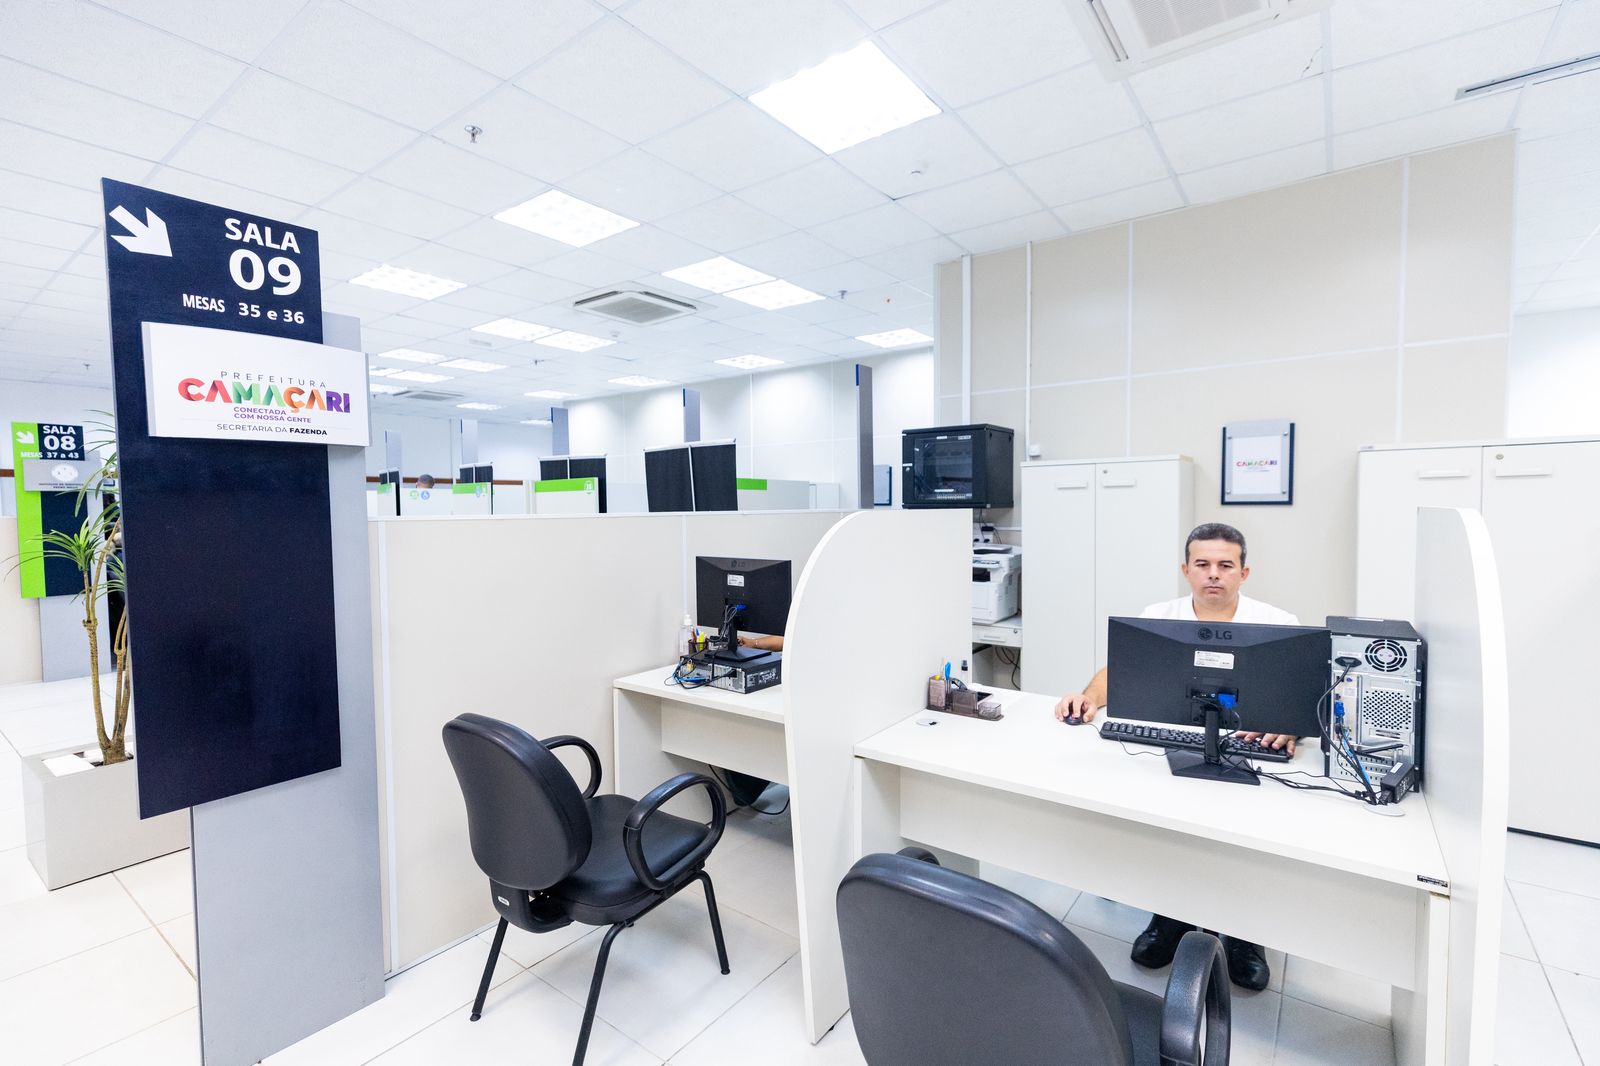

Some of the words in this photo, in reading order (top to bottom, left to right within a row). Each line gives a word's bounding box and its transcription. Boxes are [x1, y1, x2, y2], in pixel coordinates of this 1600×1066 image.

[224, 217, 301, 254] SALA
[228, 248, 302, 296] 09
[182, 293, 226, 313] MESAS
[238, 302, 261, 318] 35
[266, 308, 278, 321] e
[282, 309, 305, 325] 36
[220, 370, 327, 388] PREFEITURA
[177, 377, 350, 413] CAMAÇARI
[233, 406, 287, 415] CONECTADA
[233, 412, 255, 421] COM
[256, 414, 285, 422] NOSSA
[286, 415, 312, 424] GENTE
[42, 425, 76, 435] SALA
[216, 423, 273, 433] SECRETARIA
[289, 427, 328, 436] FAZENDA
[43, 435, 76, 451] 08
[1215, 629, 1233, 641] LG
